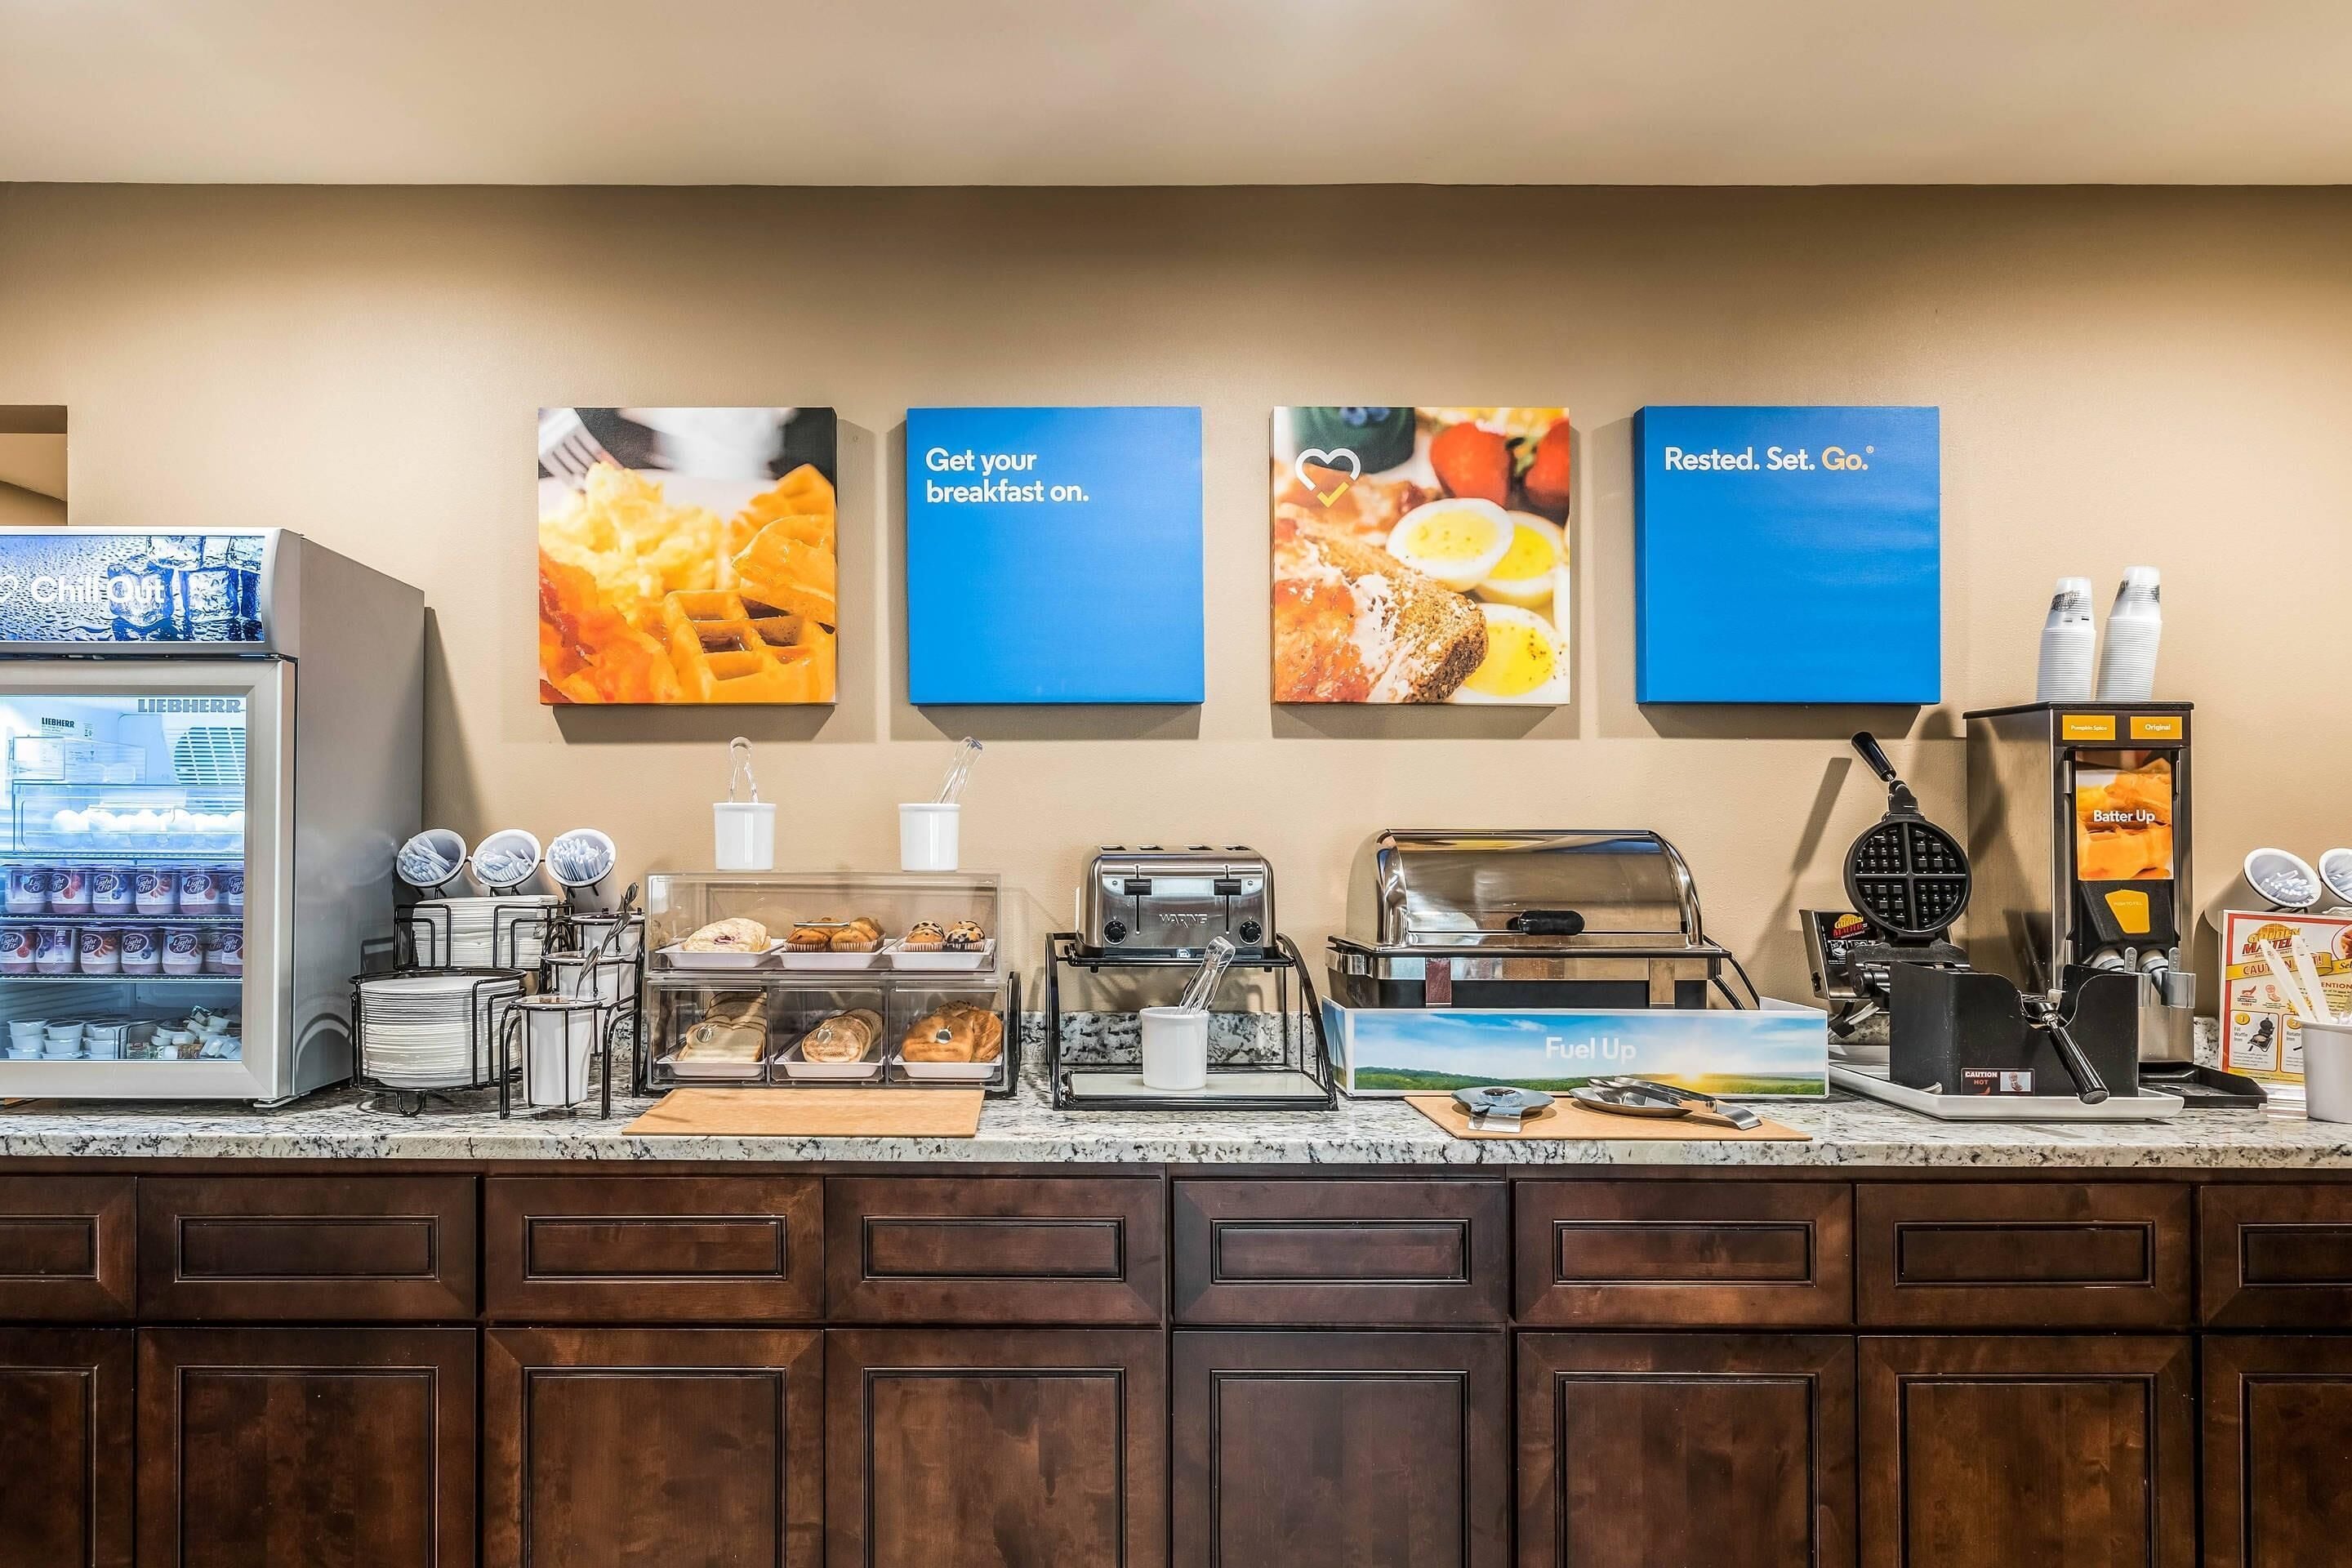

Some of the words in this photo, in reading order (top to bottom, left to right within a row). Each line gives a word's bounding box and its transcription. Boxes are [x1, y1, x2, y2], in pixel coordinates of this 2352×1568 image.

[925, 447, 975, 472] Get
[980, 452, 1037, 476] your
[1665, 446, 1761, 471] Rested.
[1766, 446, 1815, 471] Set.
[926, 478, 1045, 503] breakfast
[1049, 484, 1089, 502] on.
[31, 574, 98, 604] Chill
[108, 574, 166, 604] Out
[137, 698, 242, 714] LIEBHERR
[41, 716, 75, 728] LIEBHERR
[2145, 724, 2172, 733] Original
[2093, 809, 2134, 822] Batter
[2136, 809, 2156, 824] Up
[186, 878, 206, 888] Light
[124, 937, 142, 947] Light
[173, 937, 193, 947] Light
[2243, 960, 2292, 975] CAUTN
[1545, 1036, 1597, 1059] Fuel
[1602, 1036, 1637, 1065] Up
